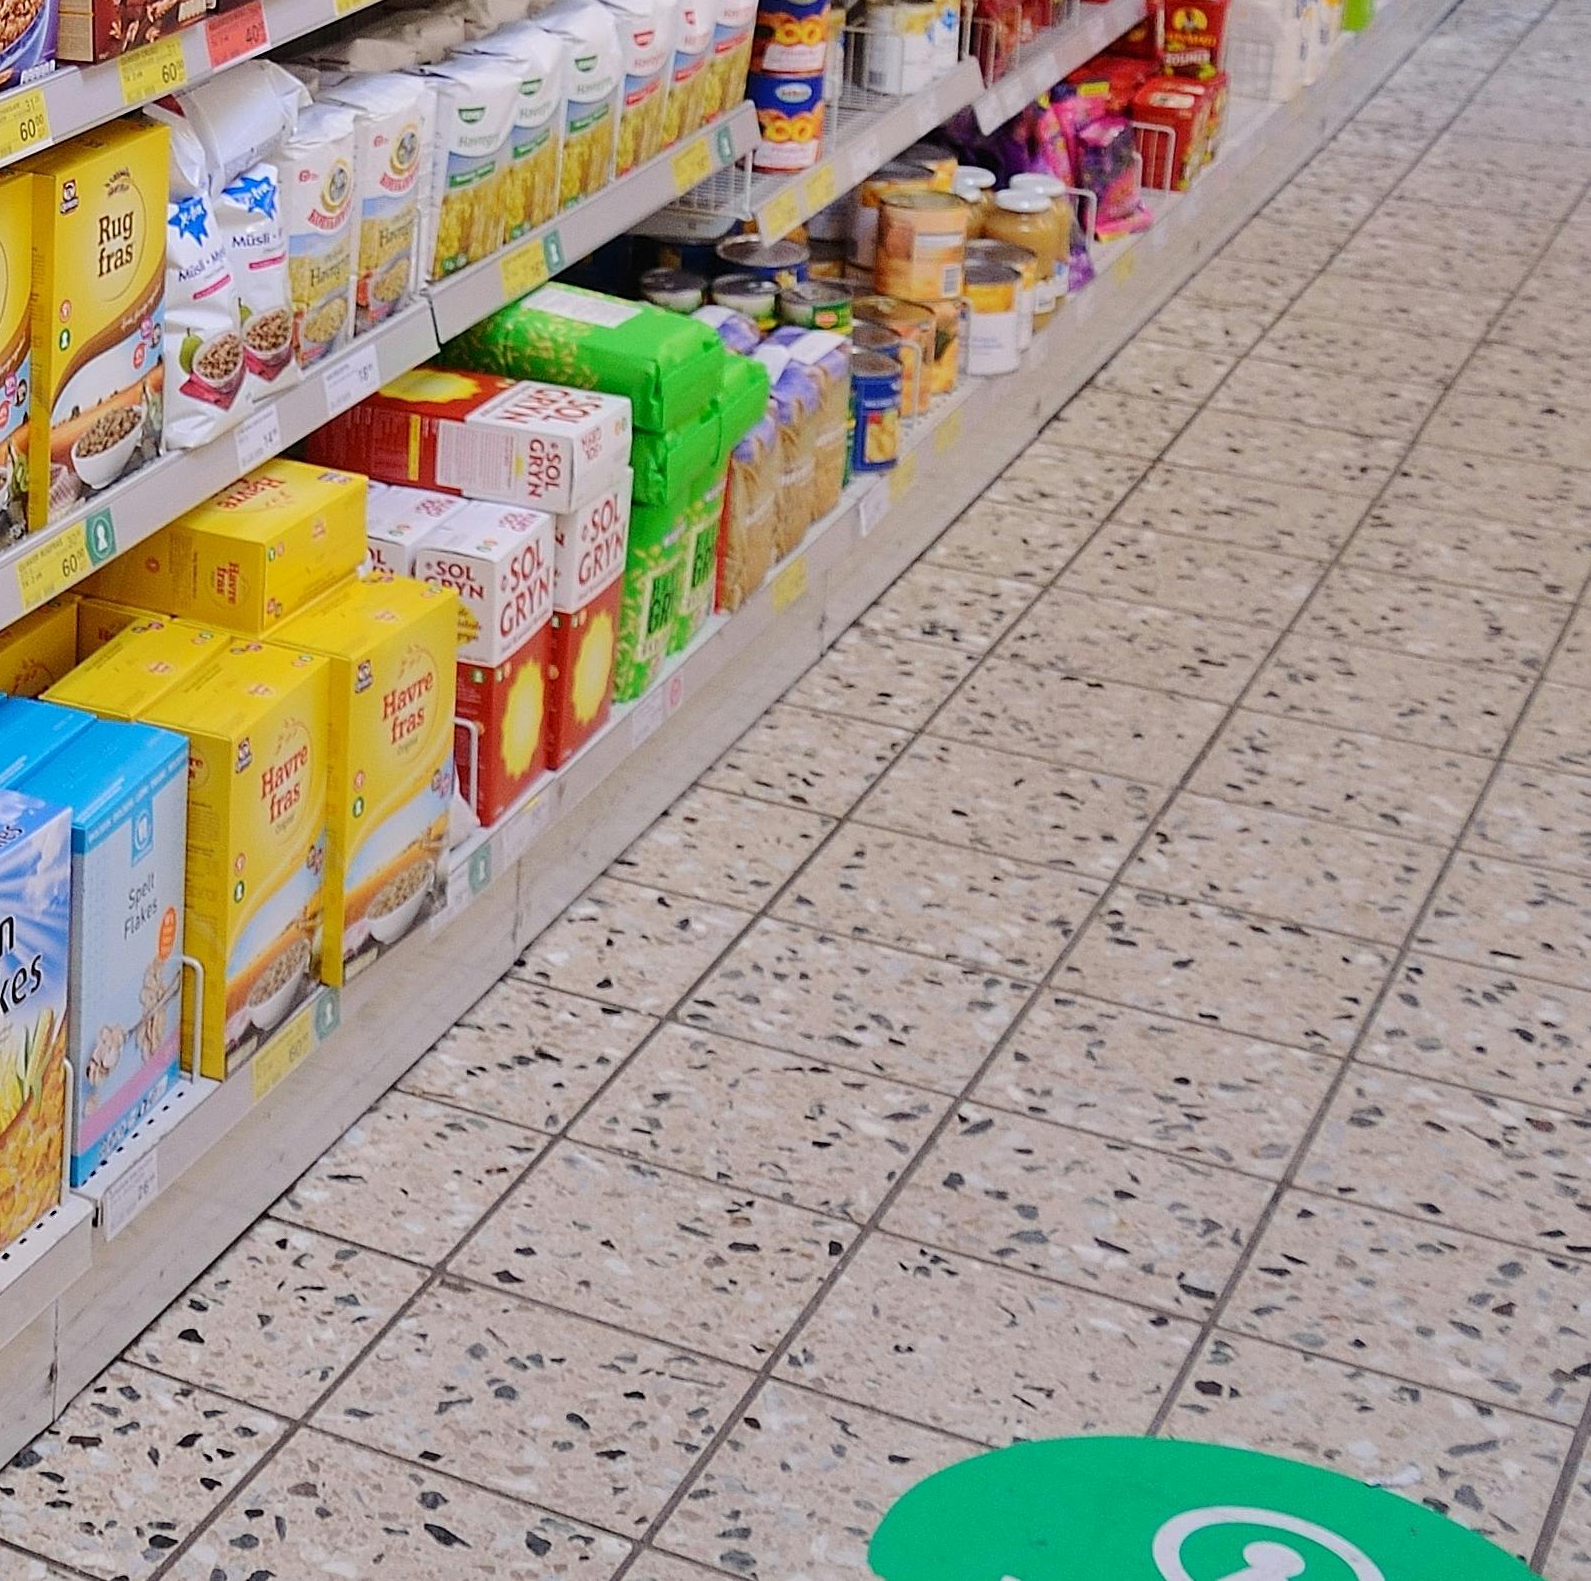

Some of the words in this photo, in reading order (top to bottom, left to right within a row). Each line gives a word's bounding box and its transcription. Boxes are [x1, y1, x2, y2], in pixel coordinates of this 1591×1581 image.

[97, 212, 135, 245] Rug
[96, 242, 134, 280] fras
[508, 537, 546, 596] SOL
[498, 569, 551, 639] GRYN
[382, 667, 436, 722] Havre
[389, 704, 426, 748] fras
[259, 741, 311, 799] Havre
[128, 872, 157, 910] Spelt
